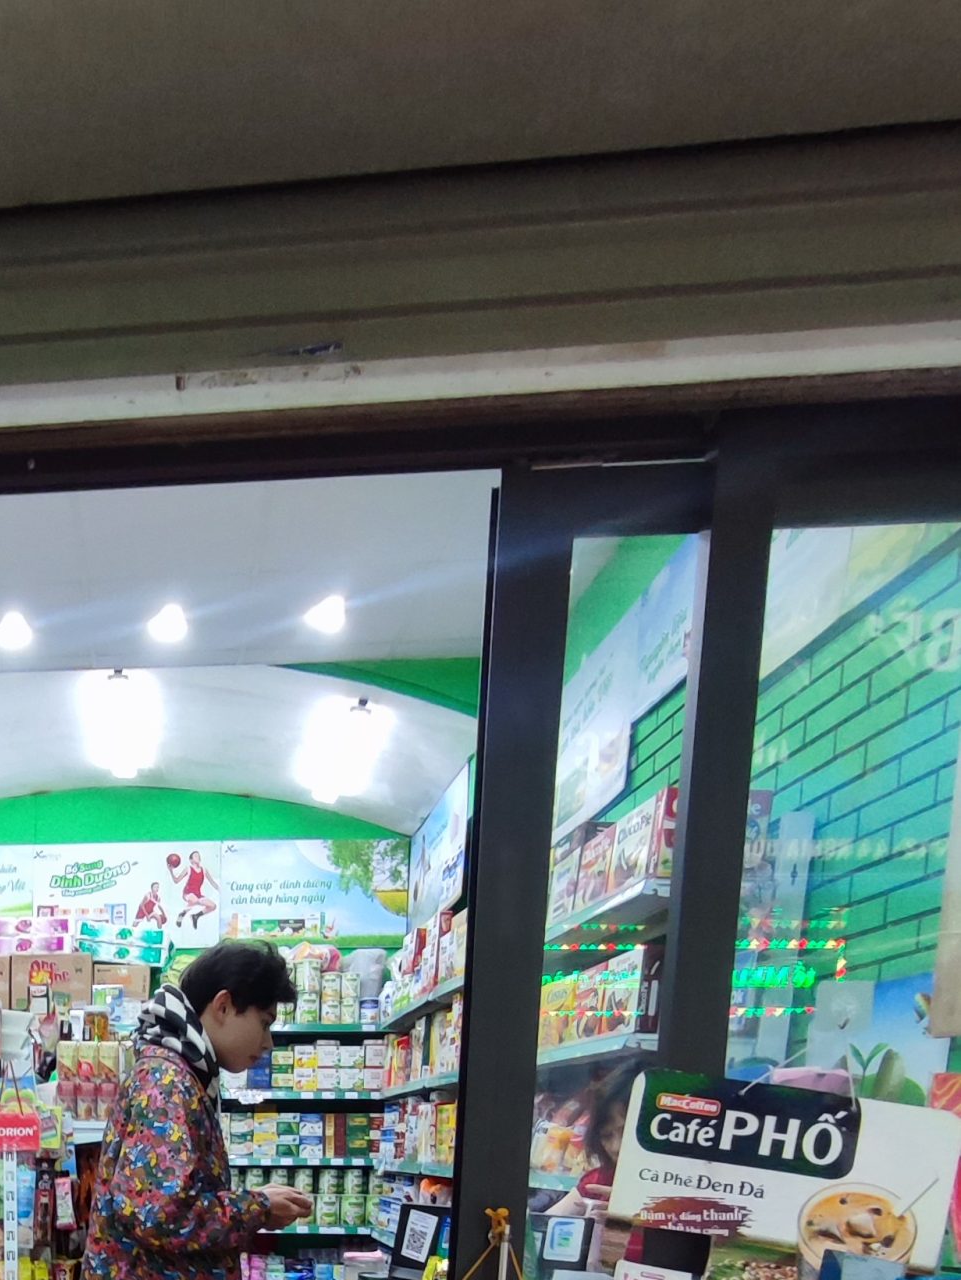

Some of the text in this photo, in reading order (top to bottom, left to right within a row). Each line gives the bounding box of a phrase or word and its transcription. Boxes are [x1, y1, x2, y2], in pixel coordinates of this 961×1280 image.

[650, 1109, 848, 1166] Café PHỐ
[663, 1172, 693, 1187] Phê
[696, 1174, 733, 1194] Đen
[739, 1181, 765, 1199] Đá
